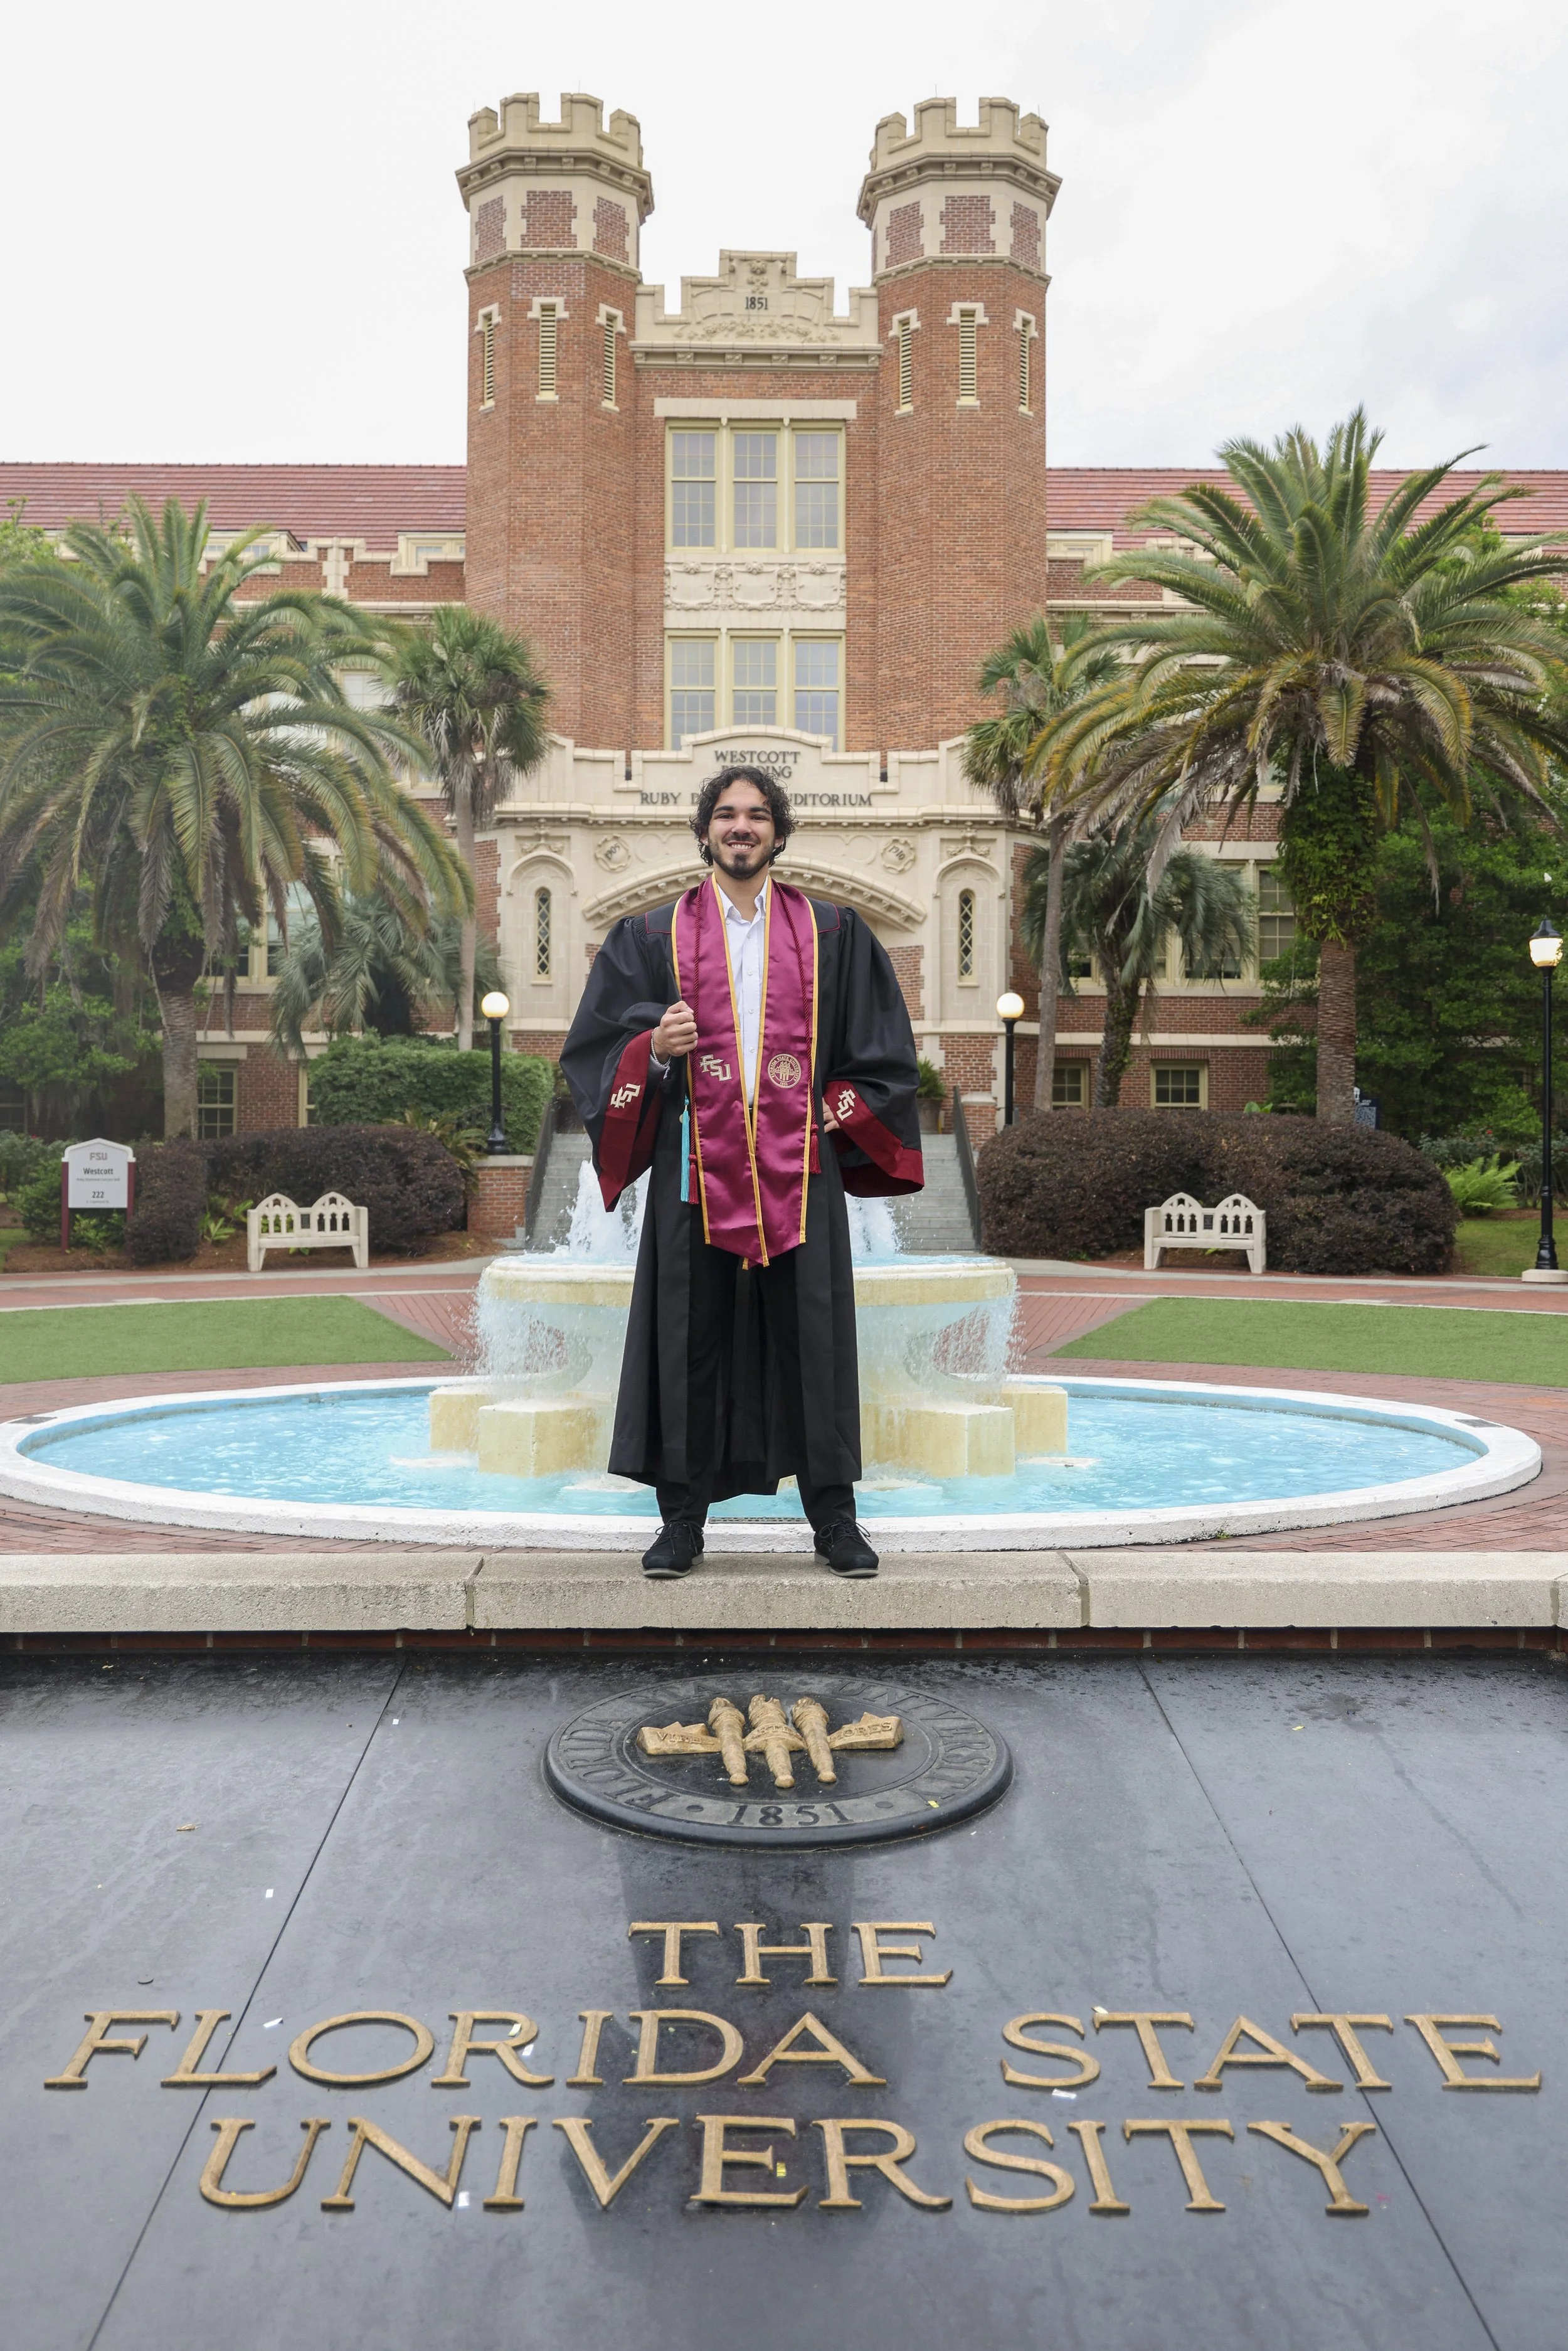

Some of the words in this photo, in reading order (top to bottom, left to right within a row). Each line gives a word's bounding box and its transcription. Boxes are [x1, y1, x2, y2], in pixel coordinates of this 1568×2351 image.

[745, 296, 768, 310] 1851
[714, 750, 801, 764] WESTCOTT
[640, 792, 681, 805] RUBY
[699, 1054, 733, 1081] FSU
[610, 1083, 640, 1108] FSU
[836, 1089, 856, 1121] FSU
[89, 1152, 108, 1160] FSU
[726, 1803, 854, 1827] 1851
[628, 1921, 953, 1986] THE
[43, 2010, 887, 2088] FLORIDA
[1002, 2011, 1542, 2091] STATE
[199, 2114, 1377, 2214] UNIVERSITY
